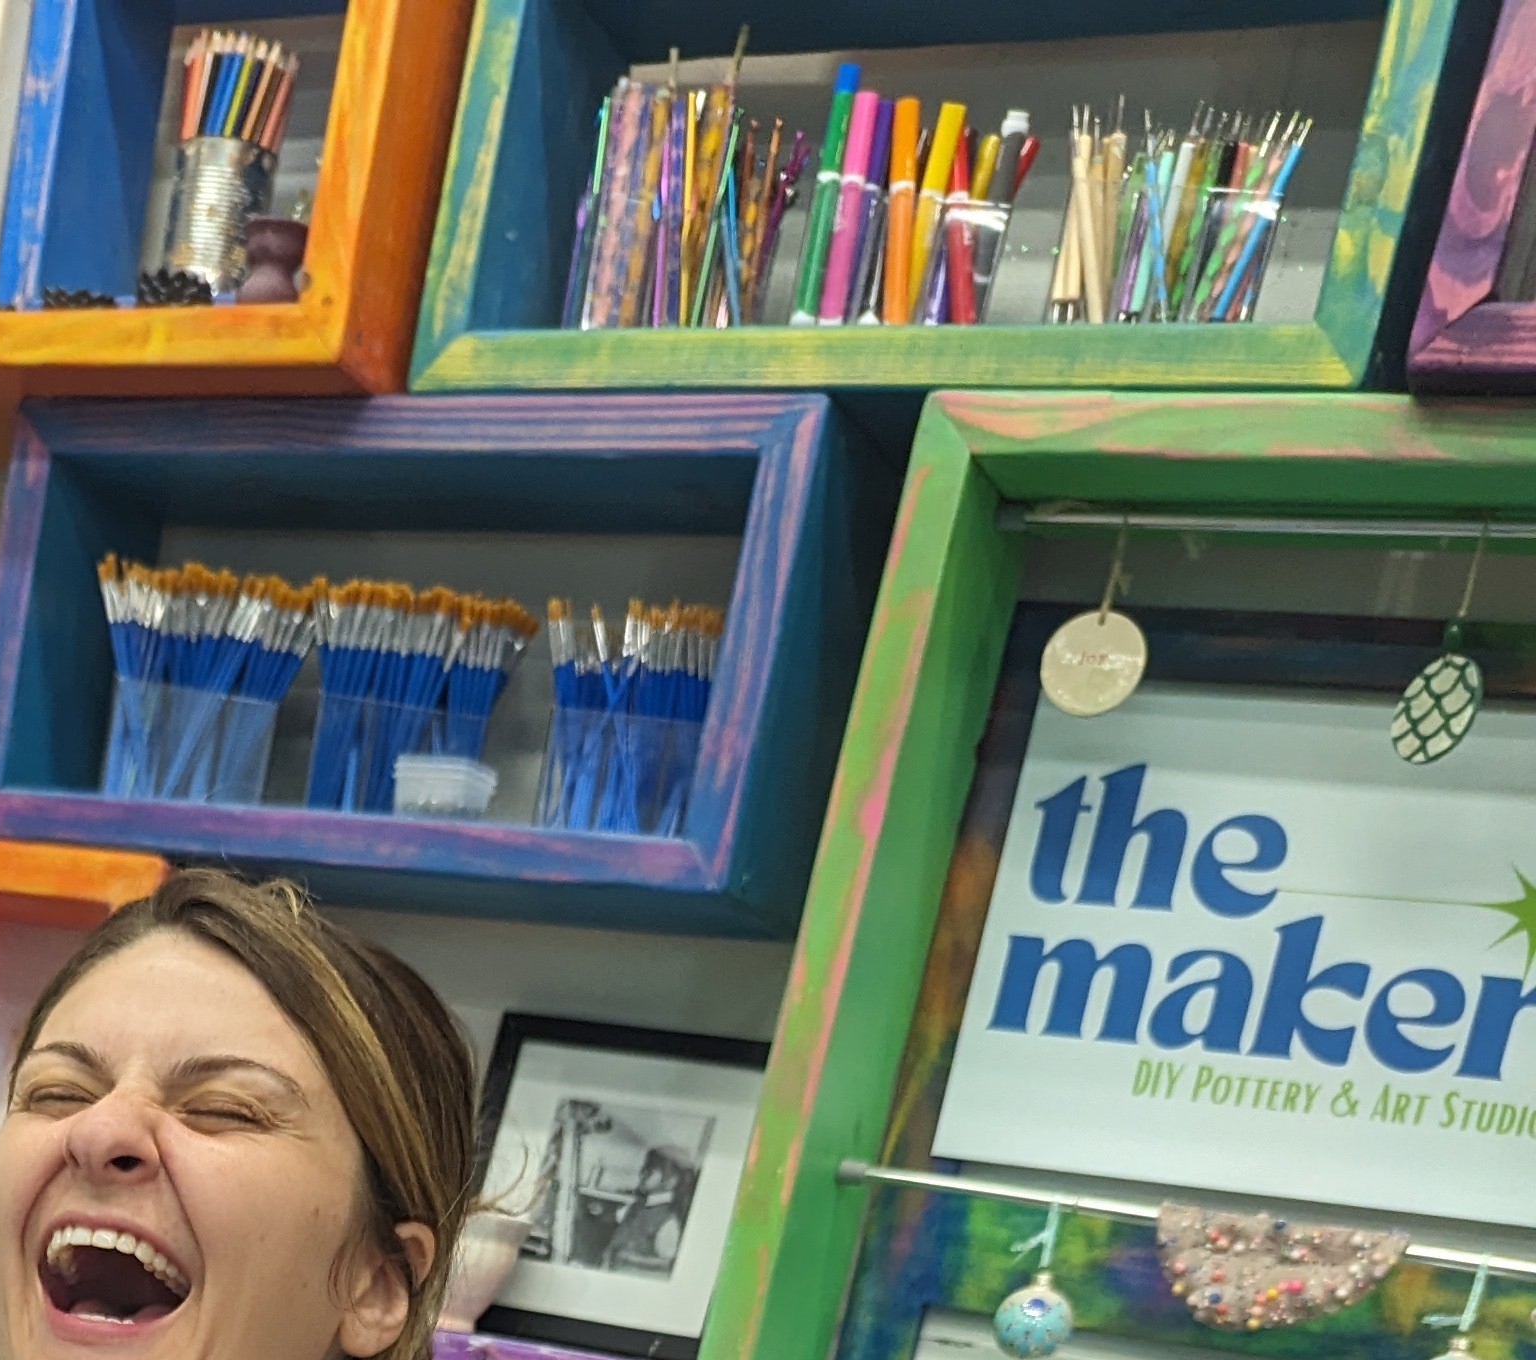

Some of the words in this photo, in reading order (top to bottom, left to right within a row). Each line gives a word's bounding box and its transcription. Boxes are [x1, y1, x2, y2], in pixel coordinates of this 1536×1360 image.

[1028, 762, 1289, 919] the
[988, 915, 1536, 1080] maker
[1131, 1058, 1187, 1100] DIY
[1329, 1080, 1360, 1119] &
